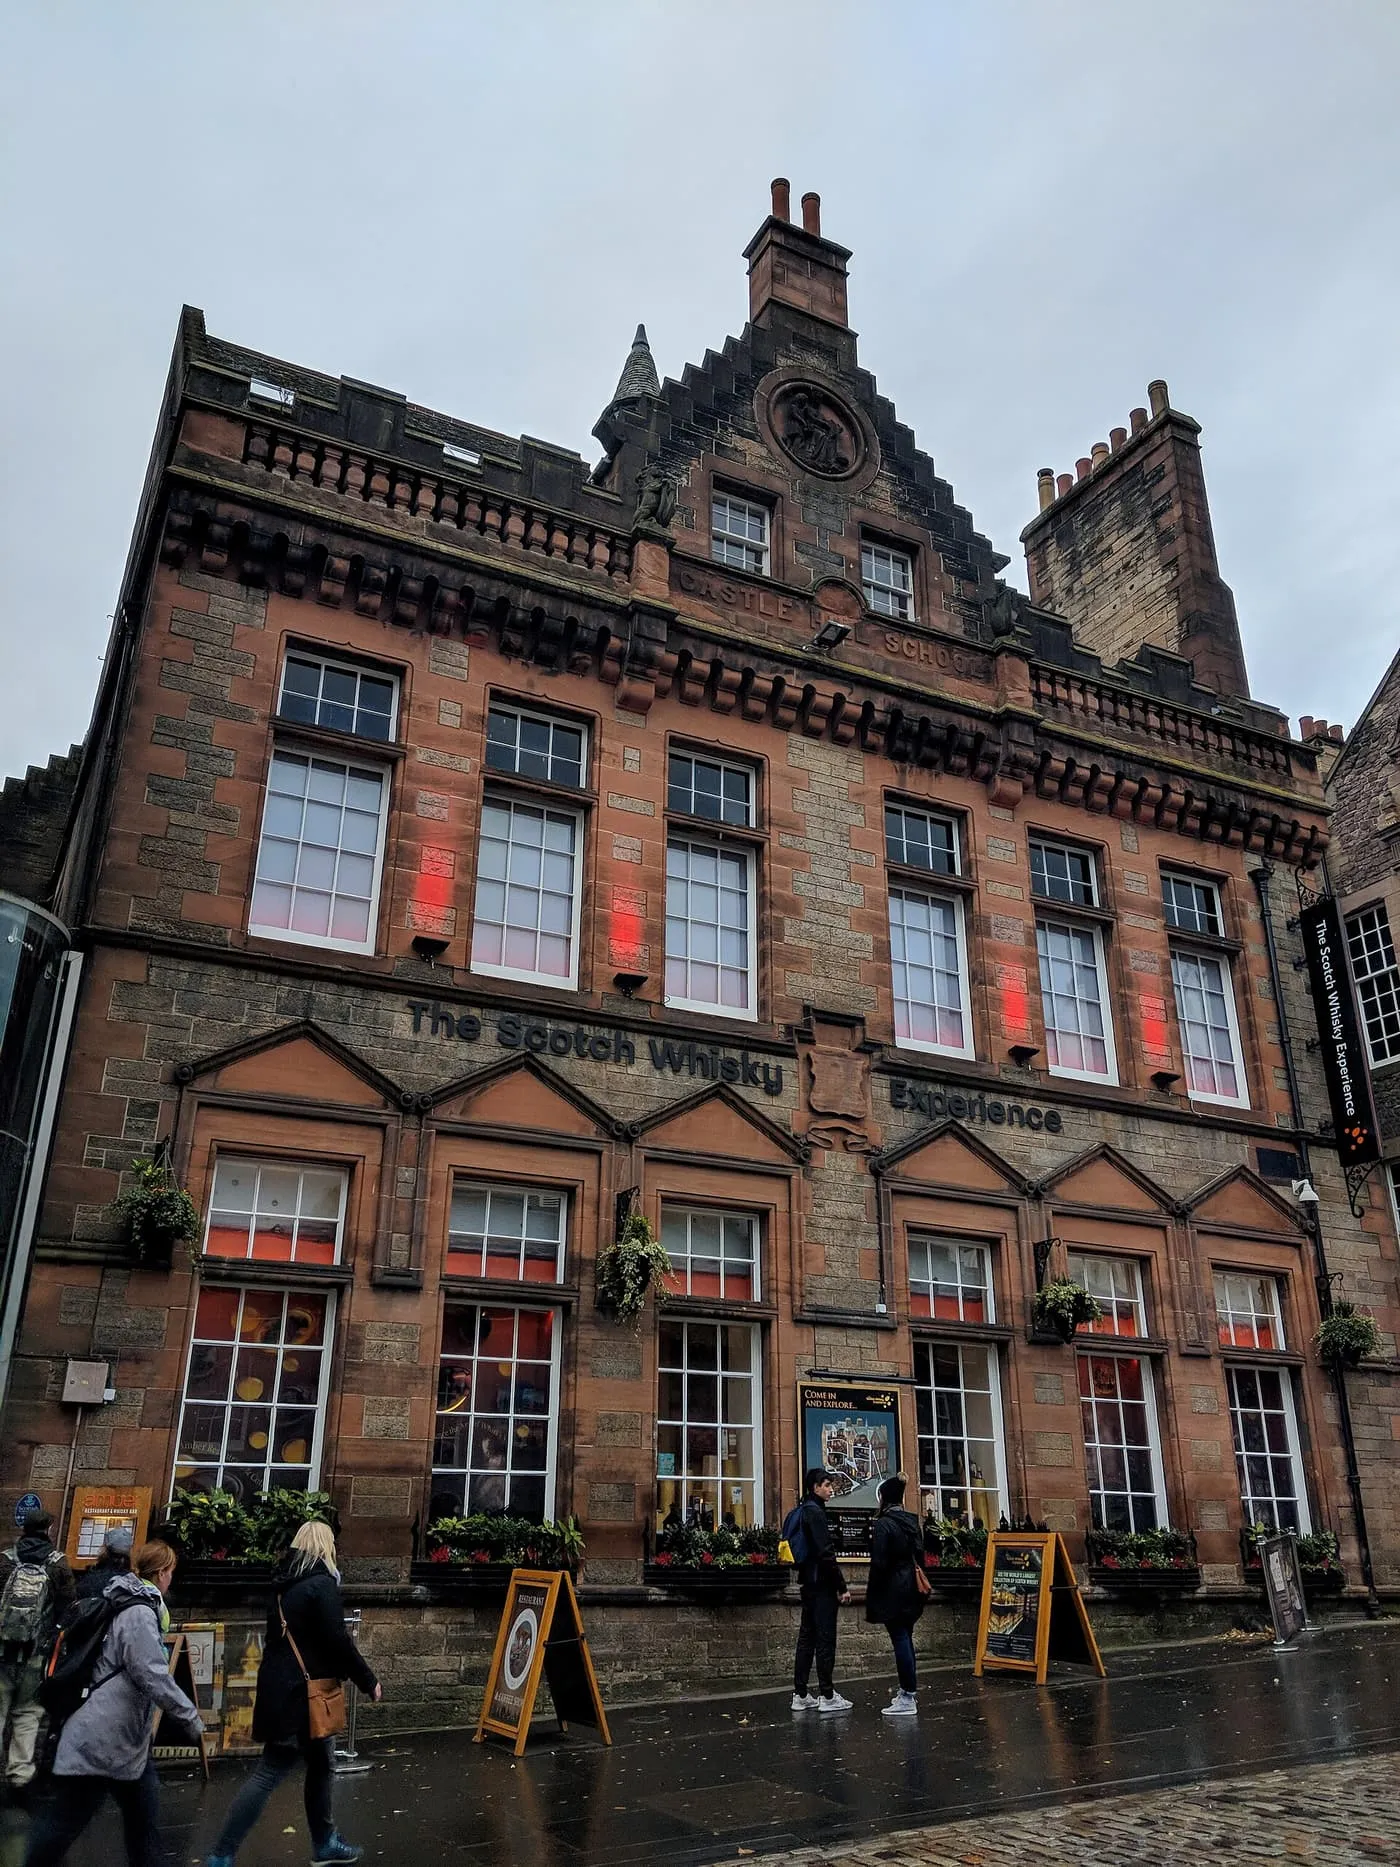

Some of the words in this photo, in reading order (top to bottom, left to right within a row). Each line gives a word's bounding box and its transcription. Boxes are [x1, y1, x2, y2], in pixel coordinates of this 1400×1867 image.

[680, 570, 793, 622] CASTLE
[884, 631, 985, 680] SCHOOL
[1315, 919, 1327, 946] The
[1320, 947, 1334, 989] Scotch
[1327, 990, 1343, 1040] Whisky
[408, 1000, 482, 1041] The
[498, 1013, 636, 1065] Scotch
[648, 1034, 783, 1097] Whisky
[890, 1079, 1064, 1133] Experience
[1336, 1043, 1355, 1117] Experience
